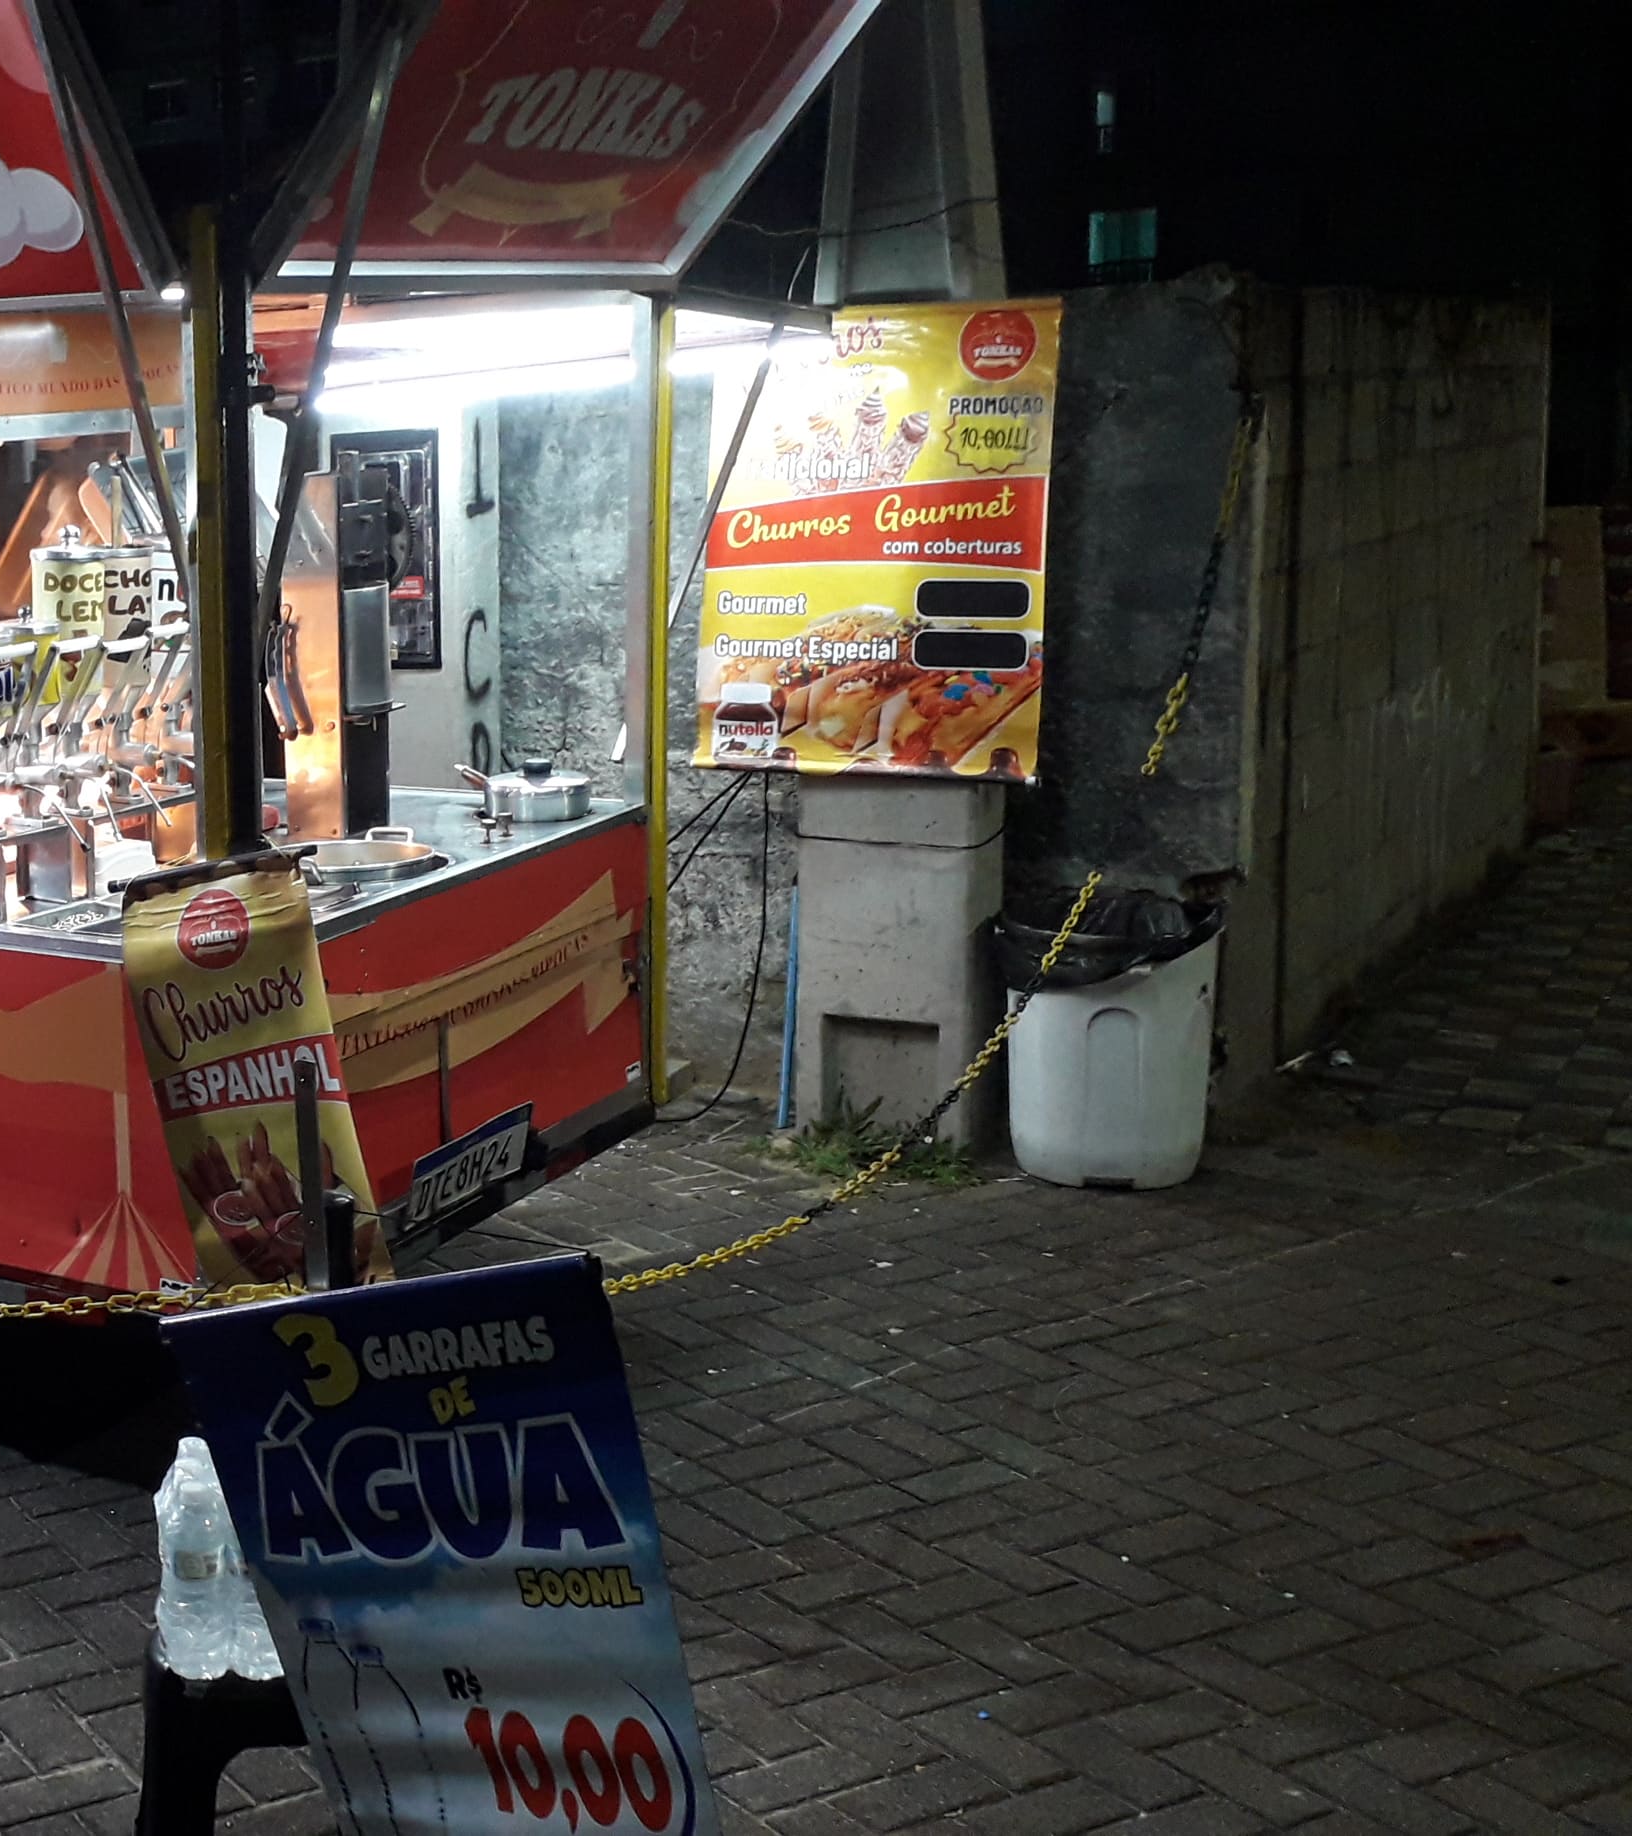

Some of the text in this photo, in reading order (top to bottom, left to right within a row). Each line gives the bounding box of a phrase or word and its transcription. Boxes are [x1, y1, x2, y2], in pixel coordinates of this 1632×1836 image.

[464, 66, 705, 160] TONKAS
[726, 485, 1016, 549] Churros Gourmet
[882, 538, 1023, 556] com coberturas
[43, 571, 103, 593] DOCE
[717, 591, 807, 615] Gourmet
[714, 635, 898, 661] Gourmet Especial
[718, 721, 774, 737] nutella
[190, 930, 237, 947] TONKAS
[142, 966, 304, 1062] Churros
[169, 1043, 341, 1109] ESPANHL
[414, 1132, 512, 1218] DTE8H24
[272, 1313, 554, 1406] 3 GARRAFAS
[429, 1376, 476, 1425] DE
[255, 1391, 627, 1563] ÁGUA
[517, 1566, 643, 1608] 500ML
[443, 1666, 483, 1701] R$
[464, 1705, 674, 1834] 10,00
